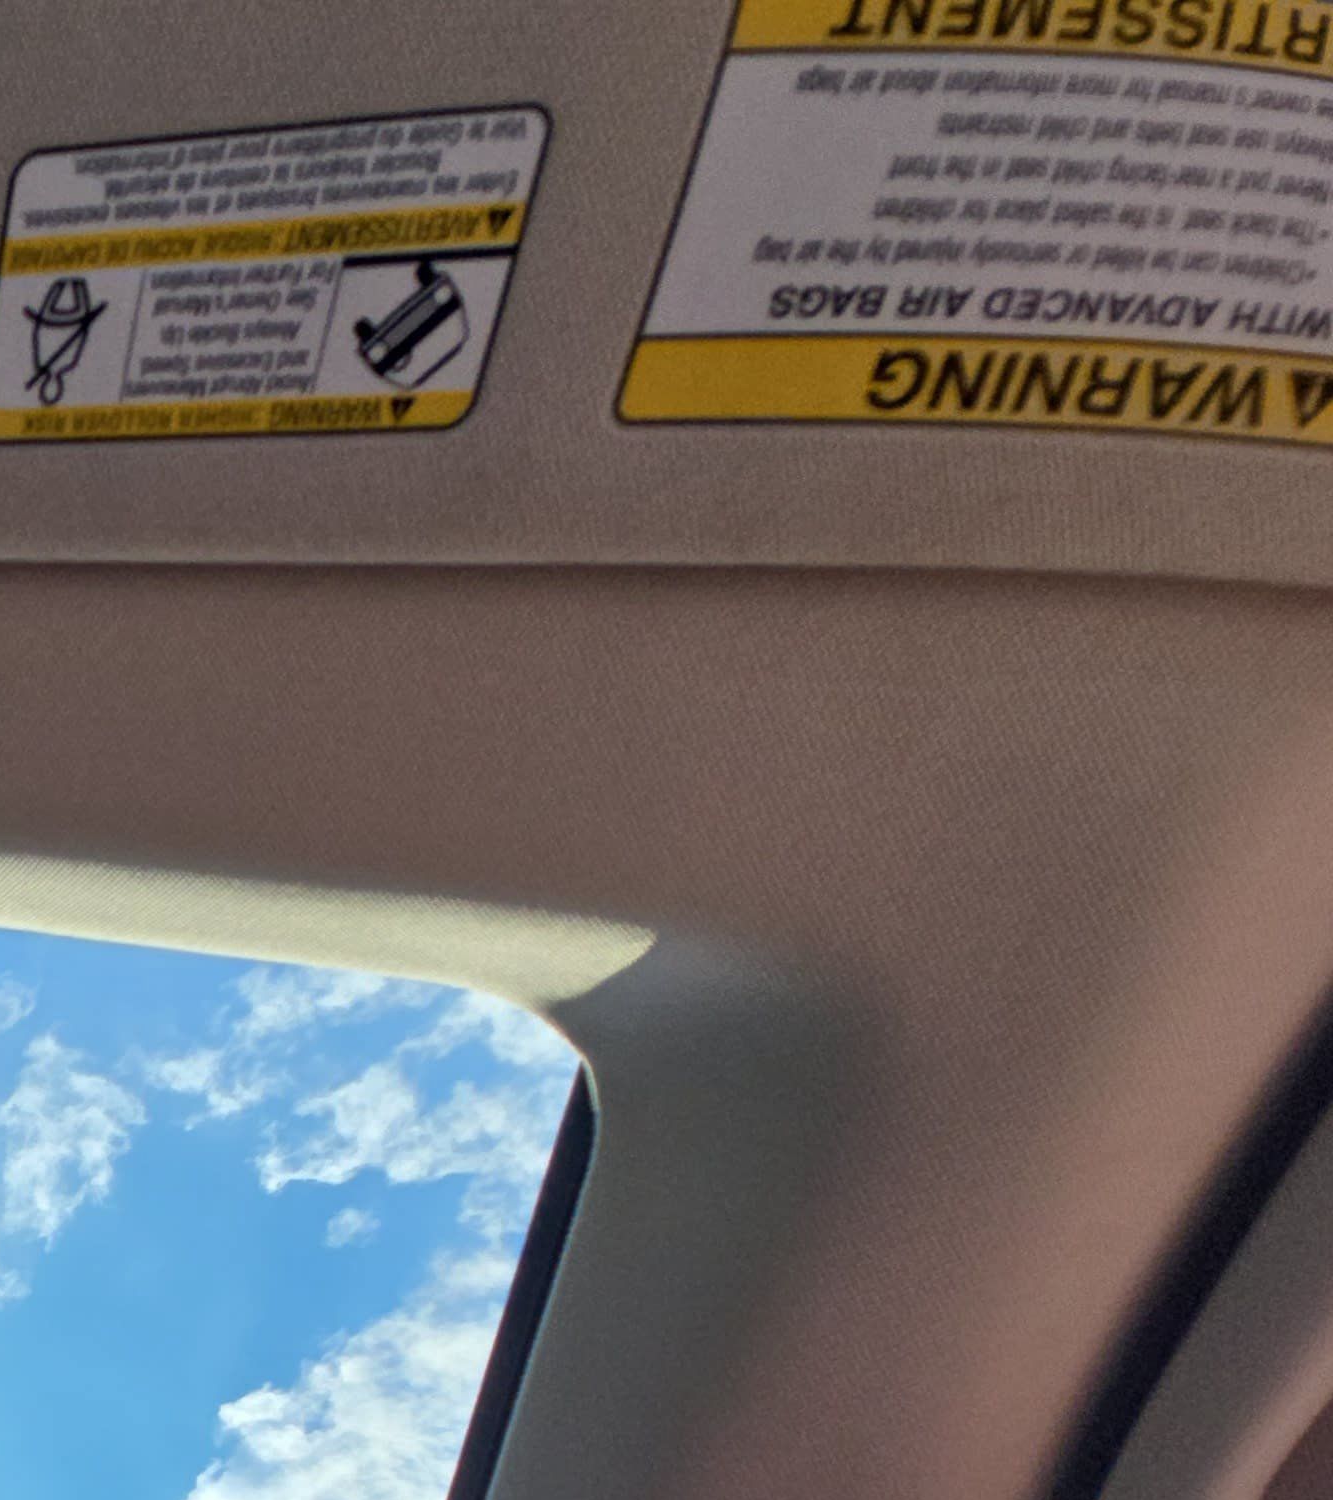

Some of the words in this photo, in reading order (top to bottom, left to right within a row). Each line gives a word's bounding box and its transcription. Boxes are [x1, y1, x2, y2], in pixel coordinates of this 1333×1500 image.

[848, 71, 877, 92] air
[879, 71, 939, 94] about
[943, 71, 1059, 95] information
[1036, 116, 1084, 141] child
[1090, 119, 1131, 141] and
[1135, 121, 1182, 145] belts
[1186, 125, 1227, 146] seat
[943, 157, 975, 182] the
[1004, 157, 1047, 181] seat
[873, 198, 954, 223] children
[958, 201, 989, 224] for
[993, 199, 1049, 223] place
[1051, 203, 1112, 228] safest
[797, 240, 823, 261] air
[826, 240, 859, 265] the
[863, 237, 892, 264] by
[893, 238, 965, 264] injured
[972, 238, 1061, 266] seriously
[1091, 246, 1147, 272] killed
[769, 285, 887, 319] BAGS
[897, 287, 973, 318] AIR
[983, 288, 1218, 328] ADVANCED
[1227, 302, 1332, 337] WITH
[867, 350, 1264, 424] WARNING
